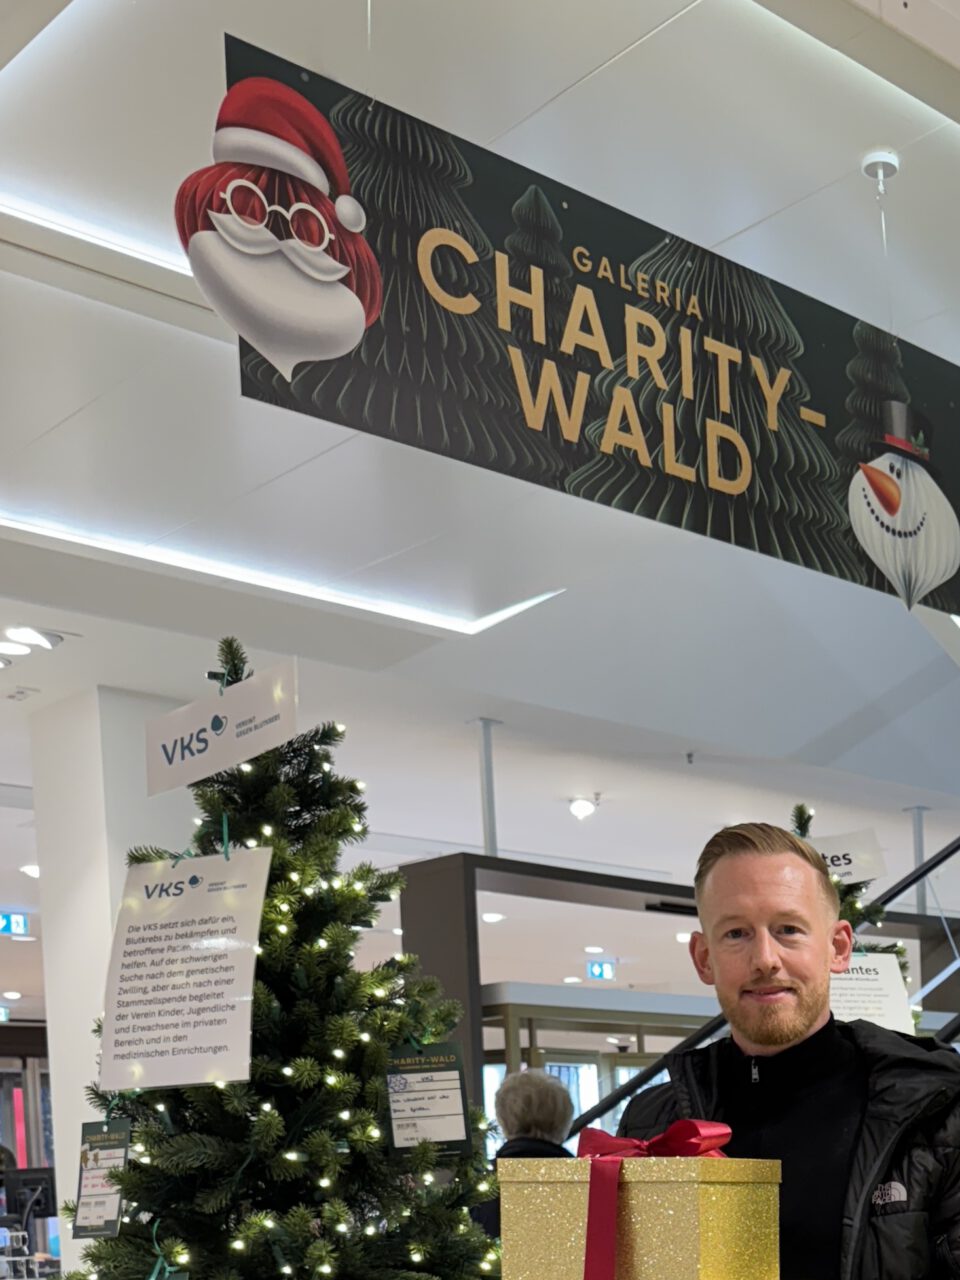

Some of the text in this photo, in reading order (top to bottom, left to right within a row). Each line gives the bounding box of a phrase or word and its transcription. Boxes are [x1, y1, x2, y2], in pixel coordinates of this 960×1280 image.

[571, 245, 704, 321] GALERIA
[416, 227, 827, 433] CHARITY-
[508, 344, 753, 496] WALD
[161, 728, 209, 766] VKS
[821, 852, 853, 868] tes
[143, 880, 186, 900] VKS
[127, 924, 141, 934] Die
[142, 923, 159, 932] VKS
[159, 920, 179, 930] setzt
[180, 918, 197, 928] sich
[198, 916, 220, 926] dafür
[125, 926, 238, 946] Blutkrebs zu bekämpfen und
[122, 946, 165, 958] betroffene
[149, 957, 165, 967] Auf
[165, 957, 179, 966] der
[180, 952, 229, 965] schwierigen
[119, 964, 236, 983] Suche nach dem genetischen
[844, 965, 880, 976] antes
[151, 983, 170, 993] aber
[170, 981, 191, 990] auch
[192, 979, 213, 988] nach
[213, 977, 236, 986] einer
[116, 991, 225, 1009] Stammzellspende begleitet
[115, 1012, 129, 1022] der
[130, 1009, 156, 1020] Verein
[186, 1003, 237, 1016] Jugendliche
[114, 1017, 228, 1034] und Erwachsene im privaten
[113, 1034, 189, 1048] Bereich und in den
[113, 1048, 170, 1061] medizinischen
